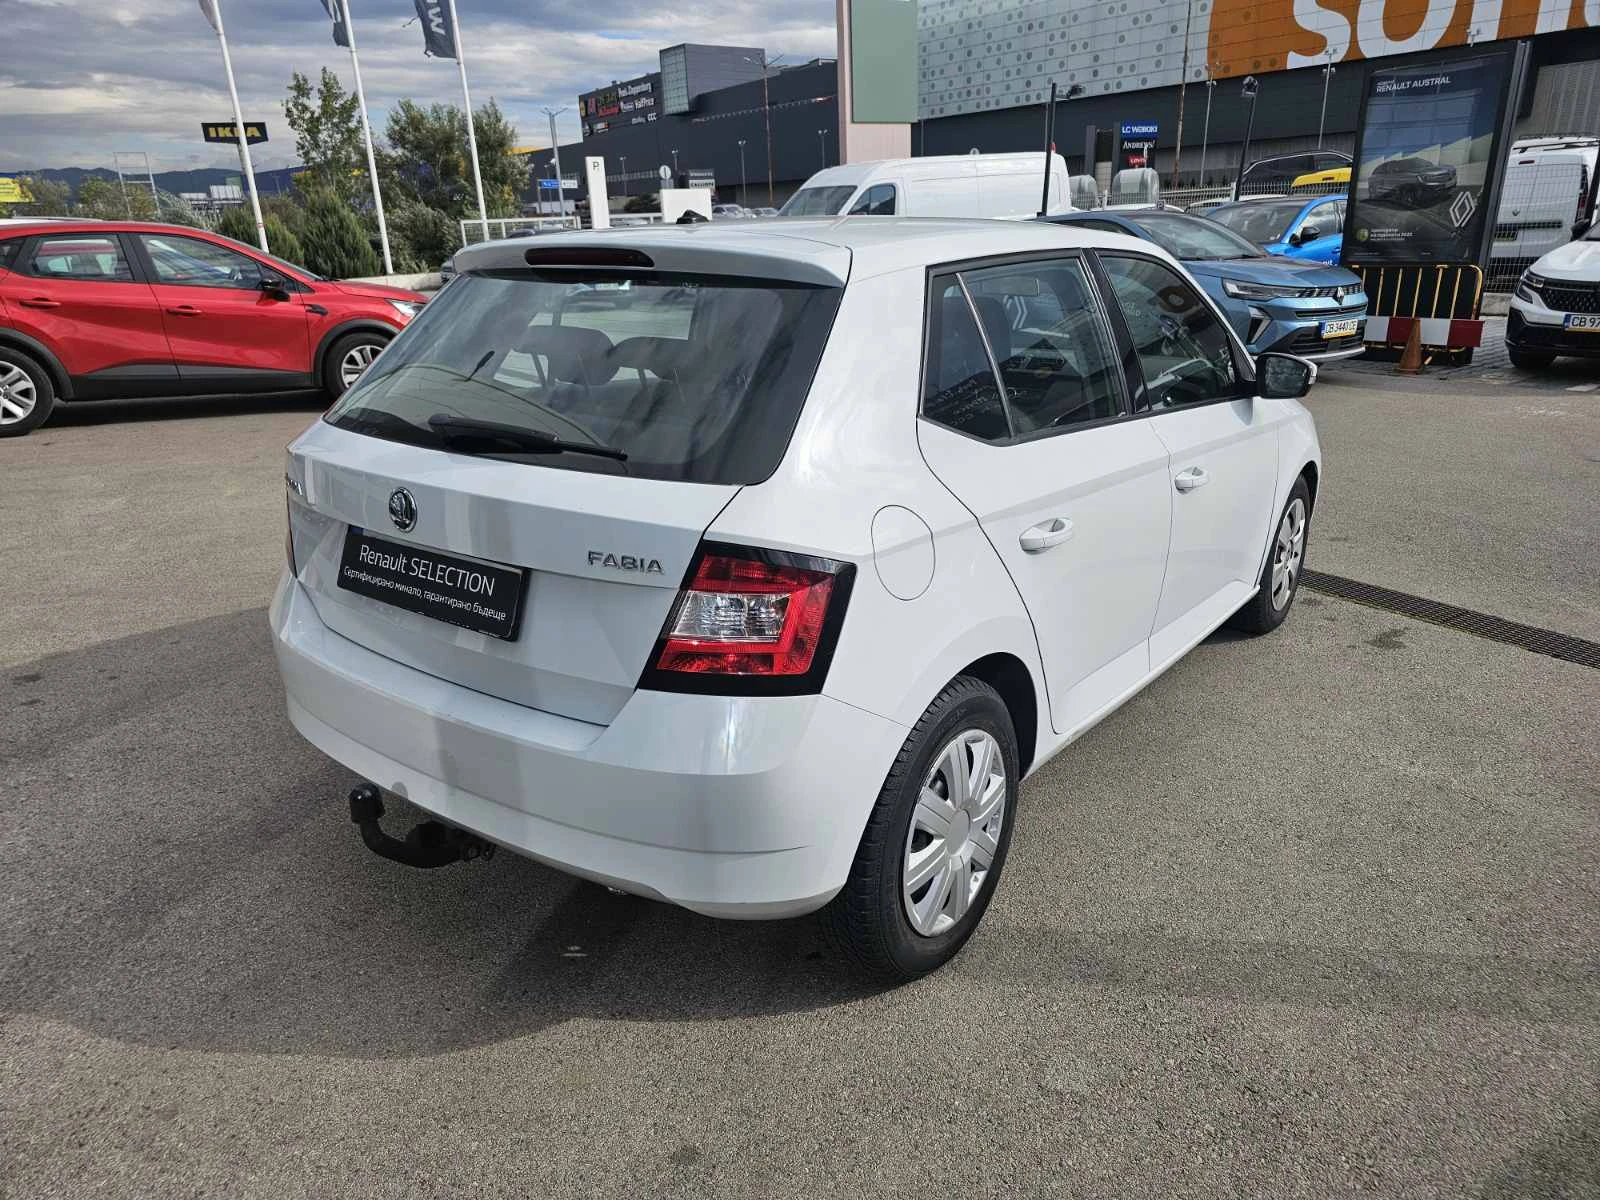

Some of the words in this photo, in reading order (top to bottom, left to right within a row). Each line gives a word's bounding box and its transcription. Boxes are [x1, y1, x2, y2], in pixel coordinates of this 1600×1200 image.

[1376, 82, 1411, 93] RENAULT
[1412, 76, 1451, 88] AUSTRAL
[647, 113, 657, 121] CCC
[359, 544, 407, 574] Renault
[408, 557, 495, 597] SELECTION
[587, 550, 665, 575] FABIA
[343, 565, 395, 589] Сертифицирано
[394, 582, 423, 598] минало,
[423, 590, 472, 611] гарантирано
[473, 601, 507, 621] бъдеще
